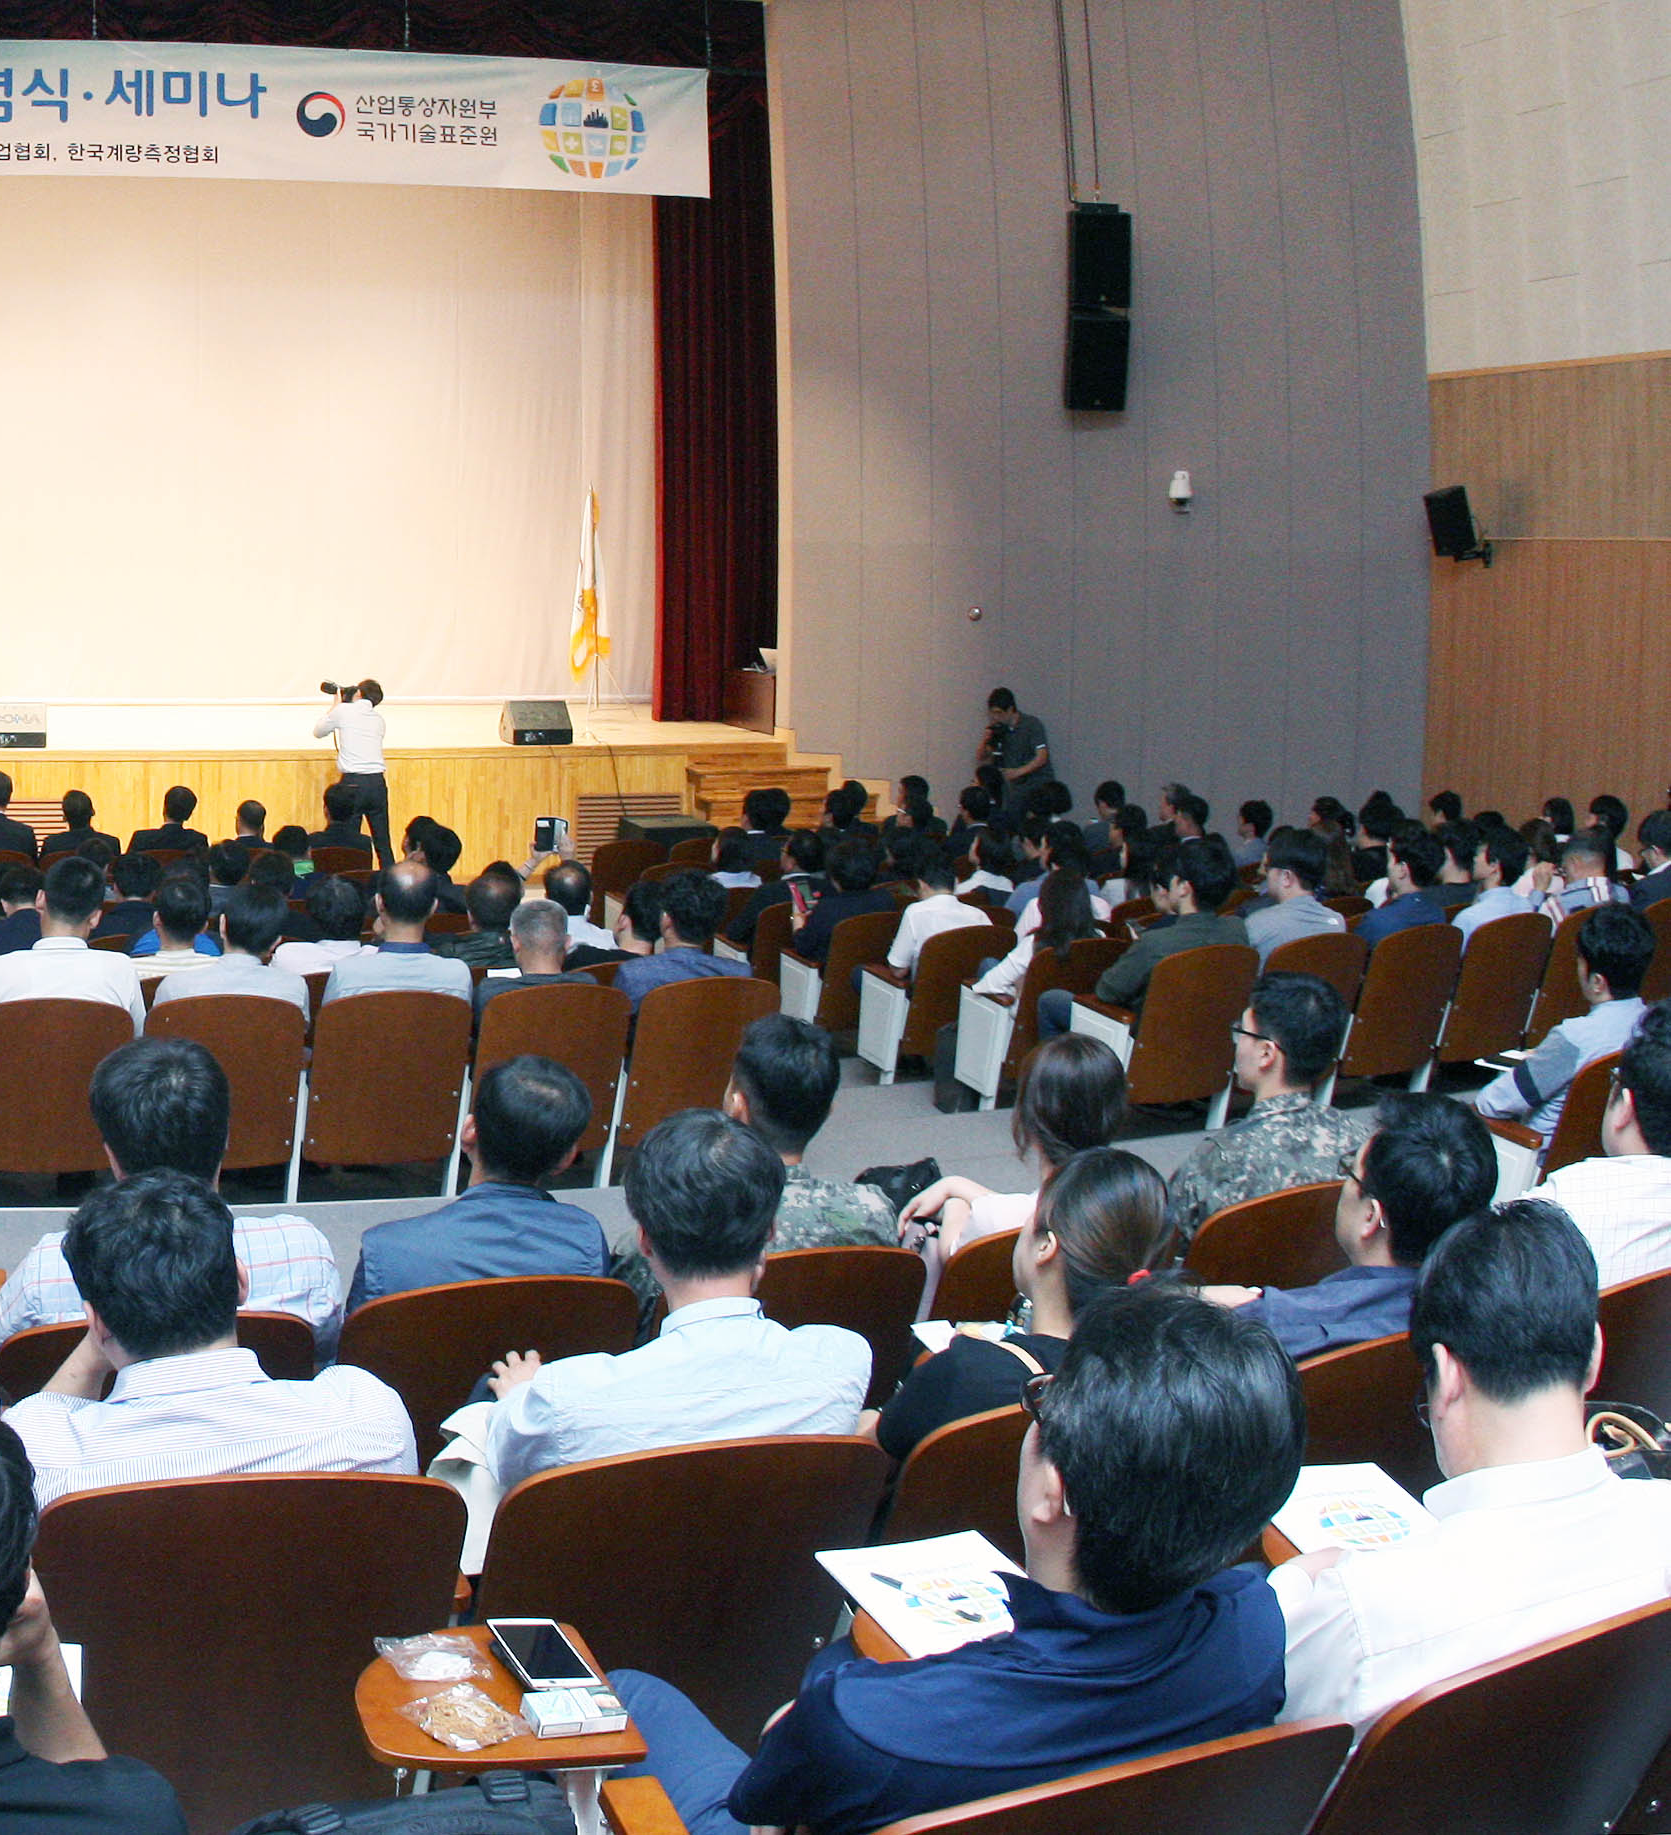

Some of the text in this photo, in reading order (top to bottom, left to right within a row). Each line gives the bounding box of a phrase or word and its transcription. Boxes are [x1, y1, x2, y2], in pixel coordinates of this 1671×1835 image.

[355, 95, 498, 120] 산업통상자원부
[356, 121, 498, 147] 국가기술표준원
[67, 142, 219, 165] 한국계량측정협회
